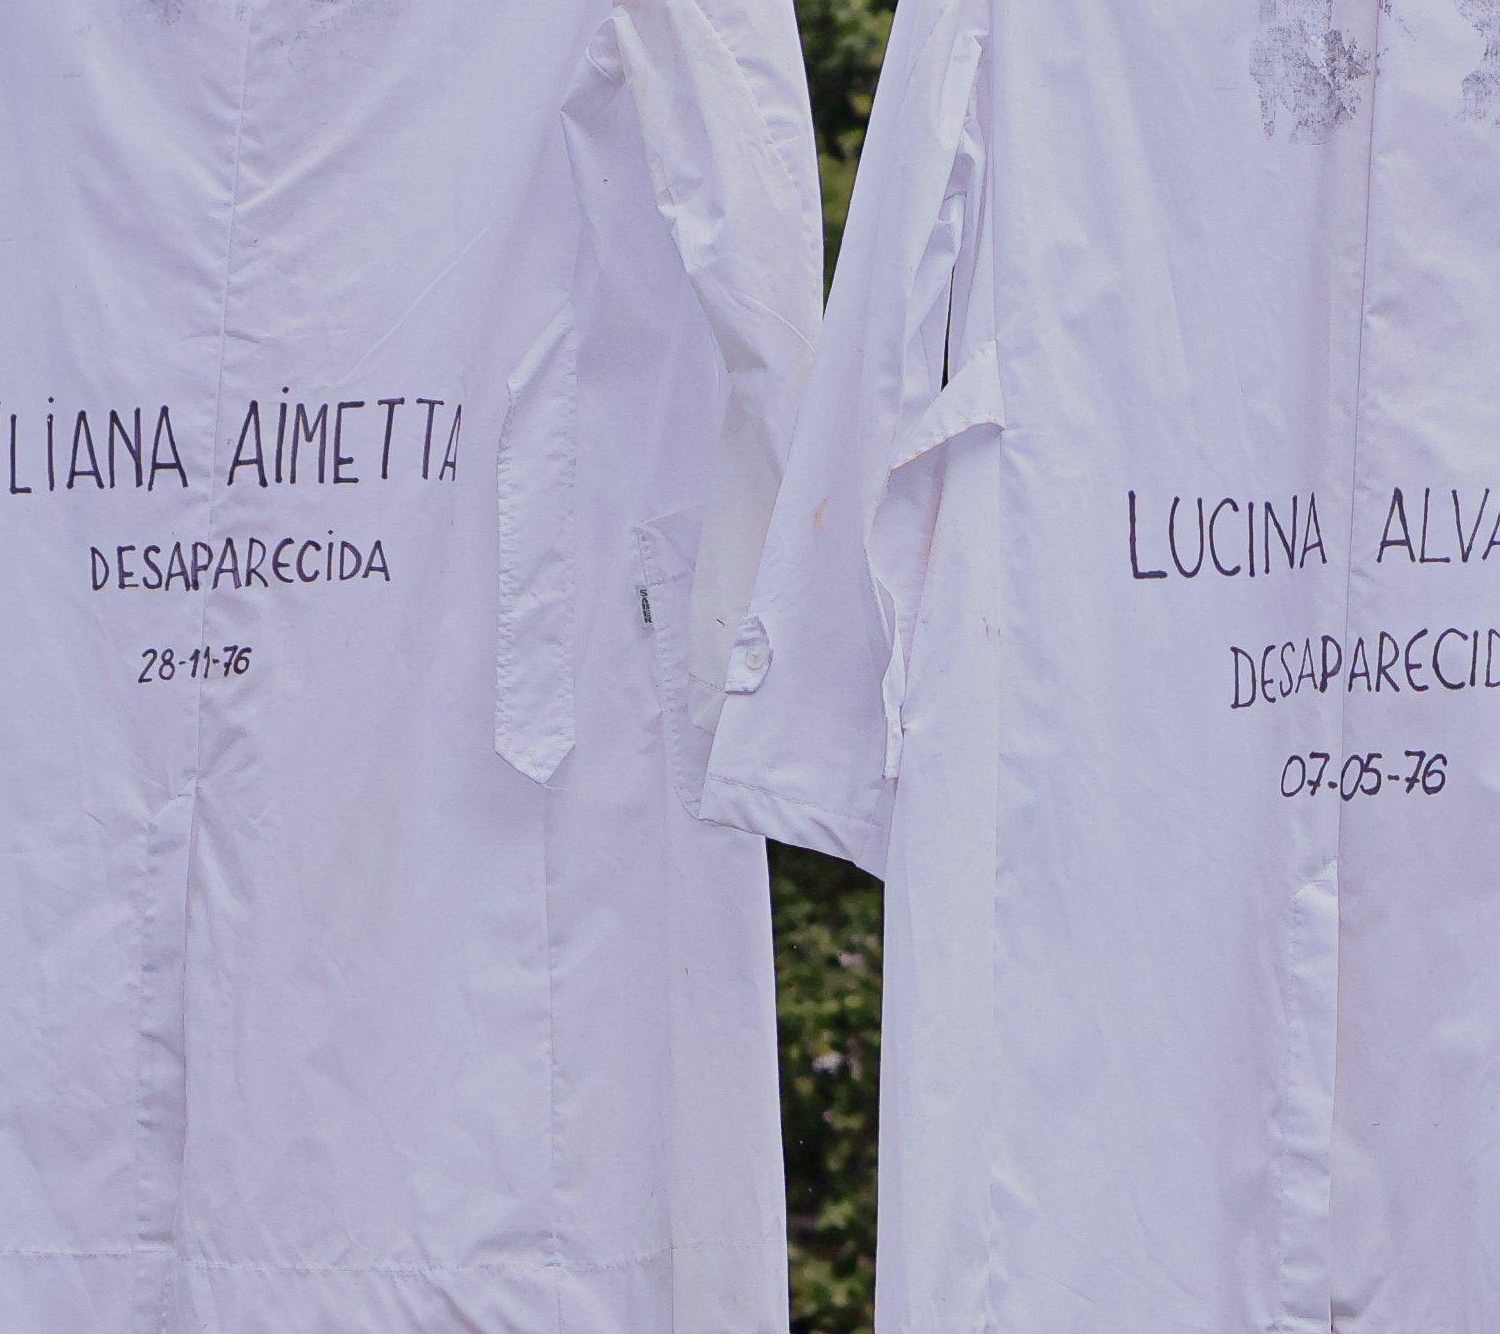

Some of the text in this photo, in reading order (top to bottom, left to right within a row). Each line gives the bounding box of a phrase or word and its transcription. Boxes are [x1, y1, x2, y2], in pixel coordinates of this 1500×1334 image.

[88, 528, 392, 593] DESAPARECIDA
[1127, 488, 1329, 581] LUCINA
[136, 643, 254, 685] 28-11-76
[1279, 748, 1449, 803] 07-05-76
